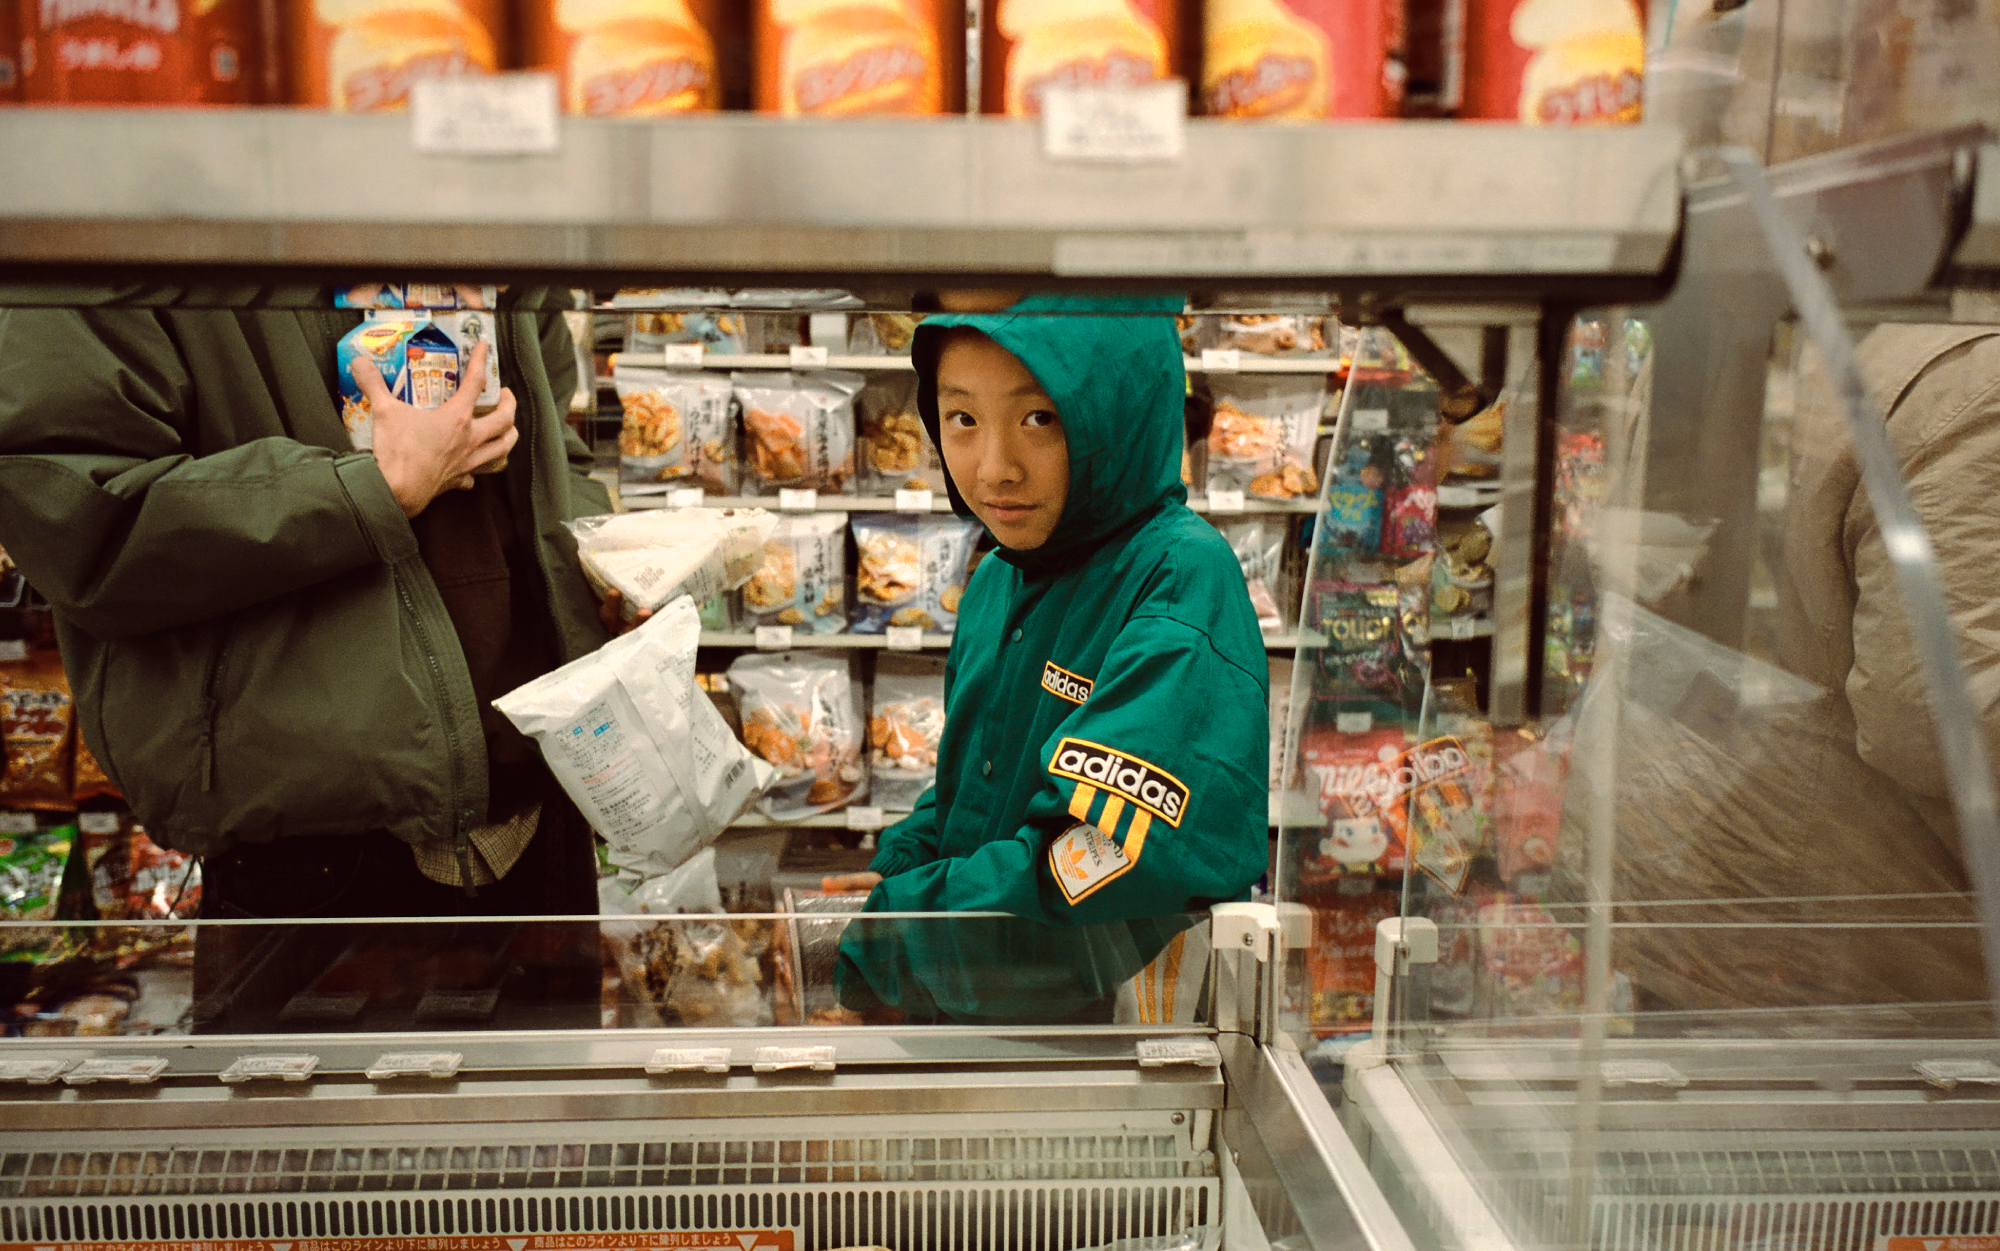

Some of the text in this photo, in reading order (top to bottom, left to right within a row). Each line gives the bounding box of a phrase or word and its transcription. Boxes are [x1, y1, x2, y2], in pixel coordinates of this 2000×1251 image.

[1043, 669, 1089, 702] adidas
[1058, 749, 1181, 818] adidas
[534, 1233, 732, 1248] 商品はこのラインより下に陳列しましょう
